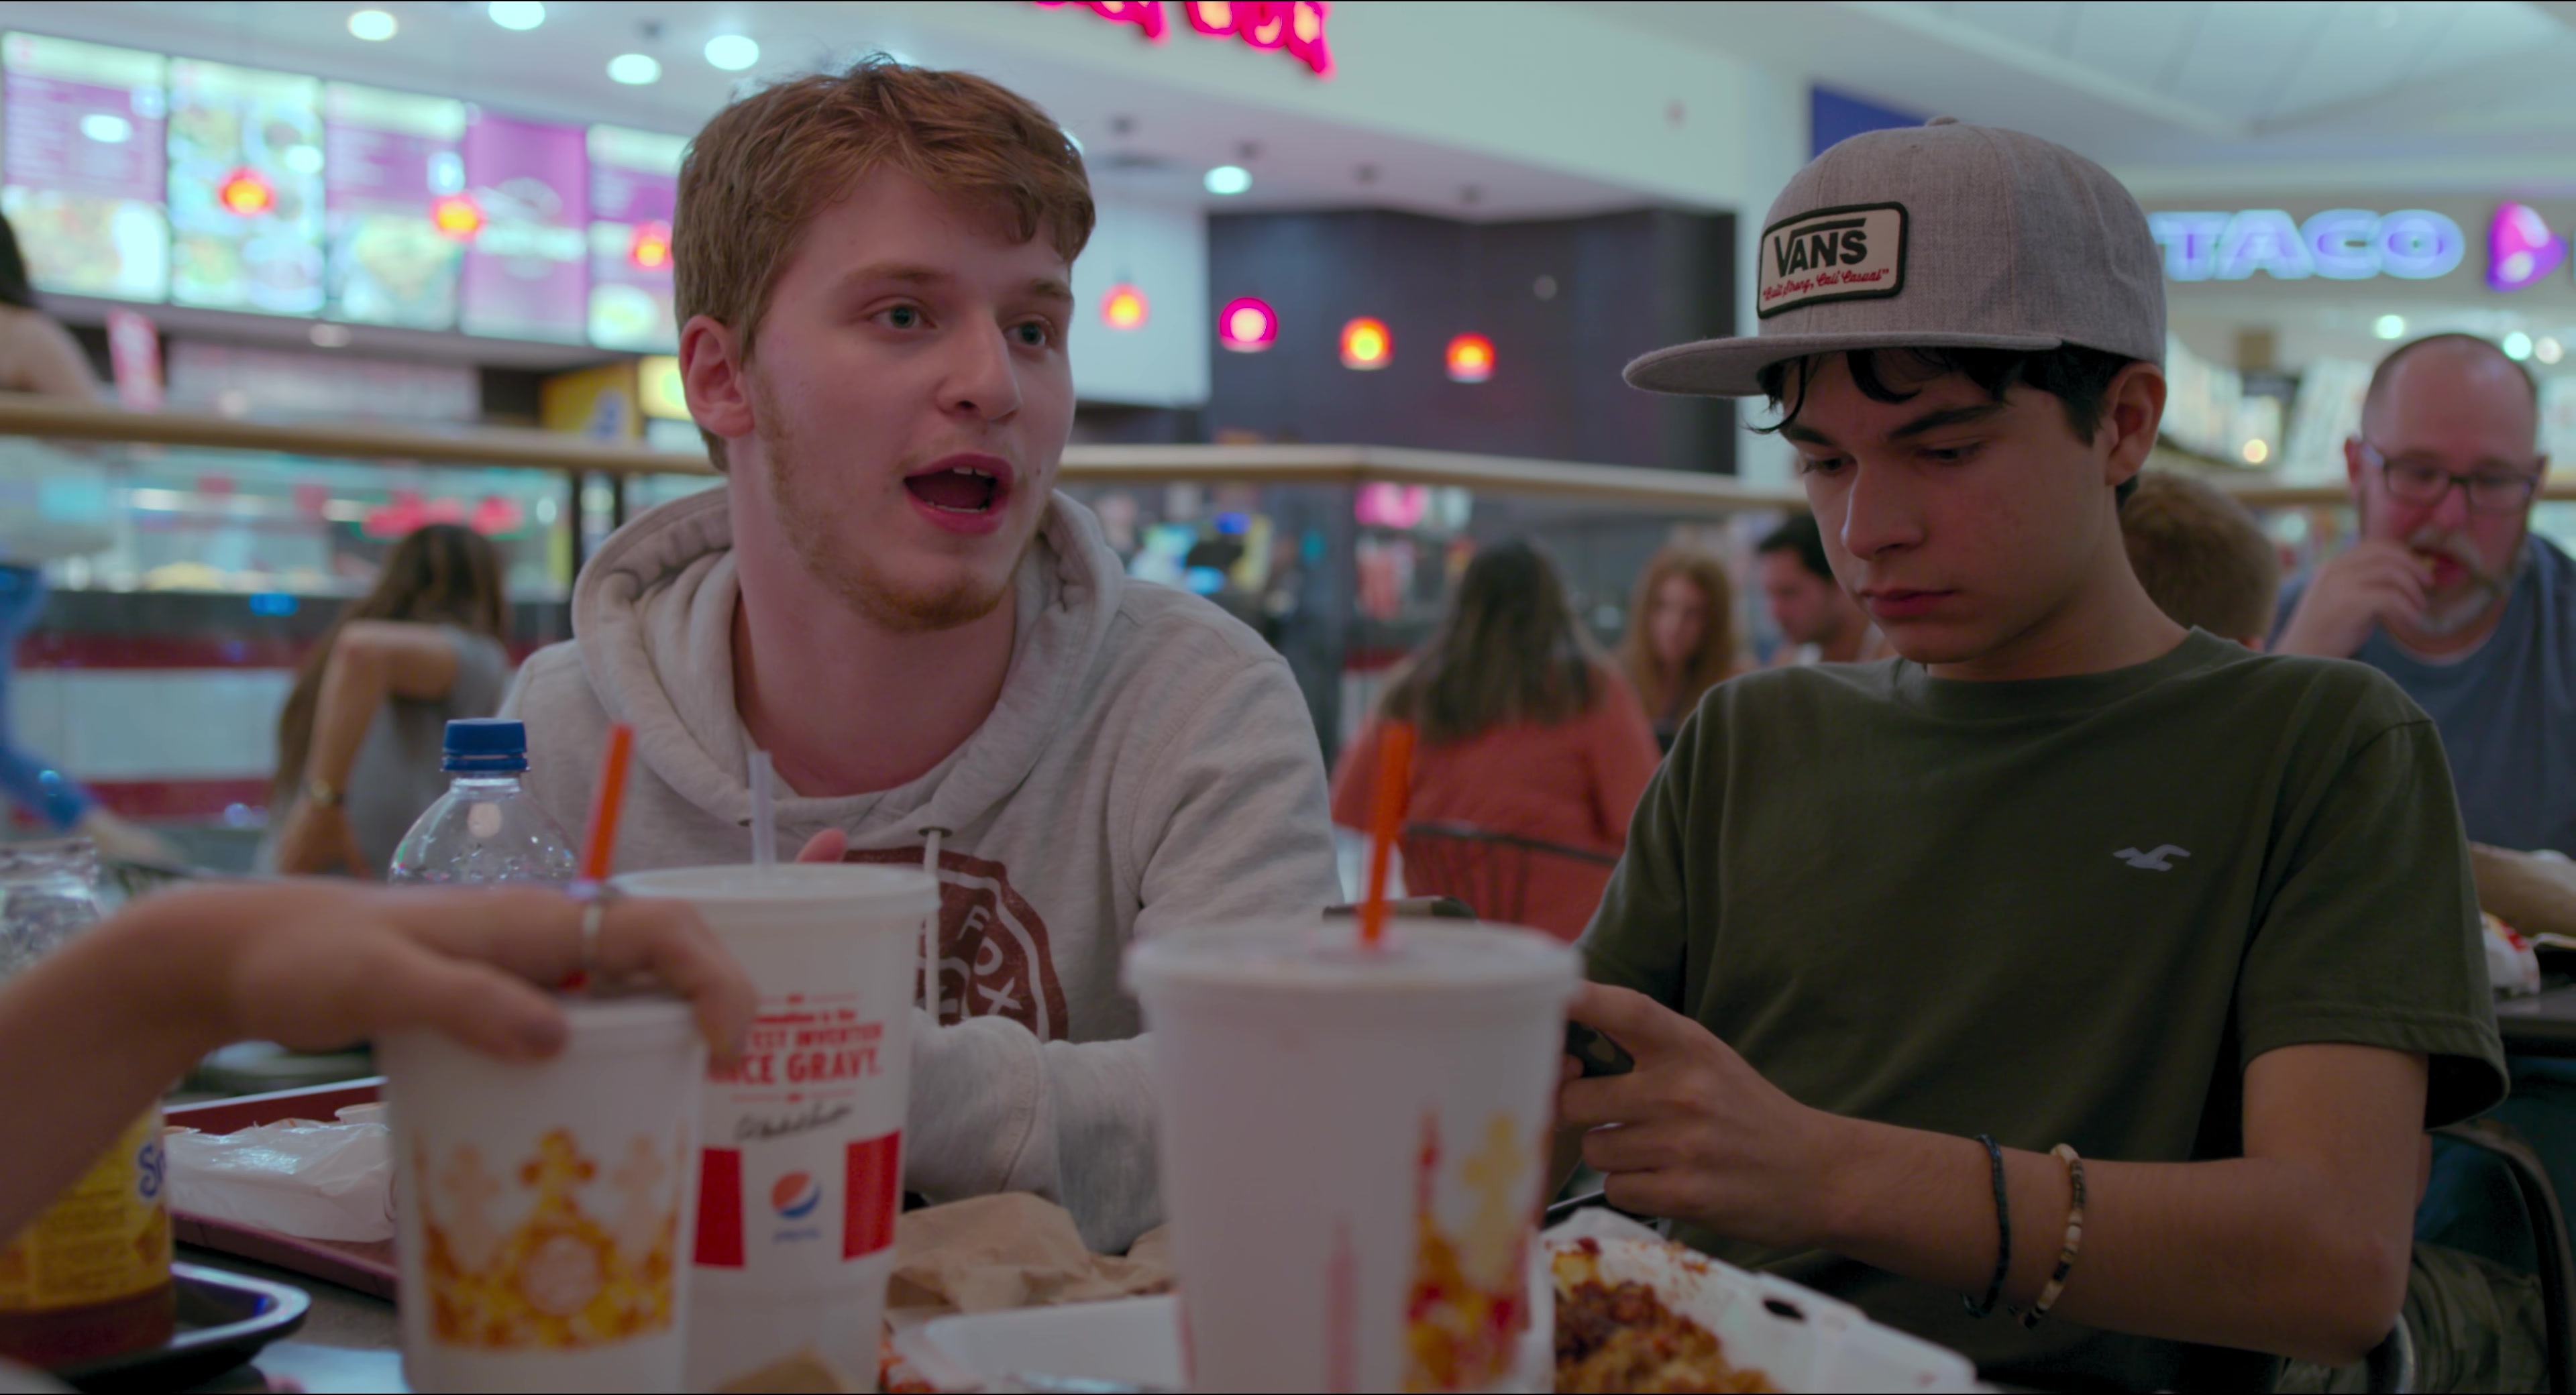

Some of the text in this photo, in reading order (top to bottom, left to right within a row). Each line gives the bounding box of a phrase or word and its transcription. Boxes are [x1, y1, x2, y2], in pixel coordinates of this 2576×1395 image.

[1774, 218, 1868, 278] VANS
[2147, 209, 2465, 282] TACO
[955, 905, 1024, 1015] FOX
